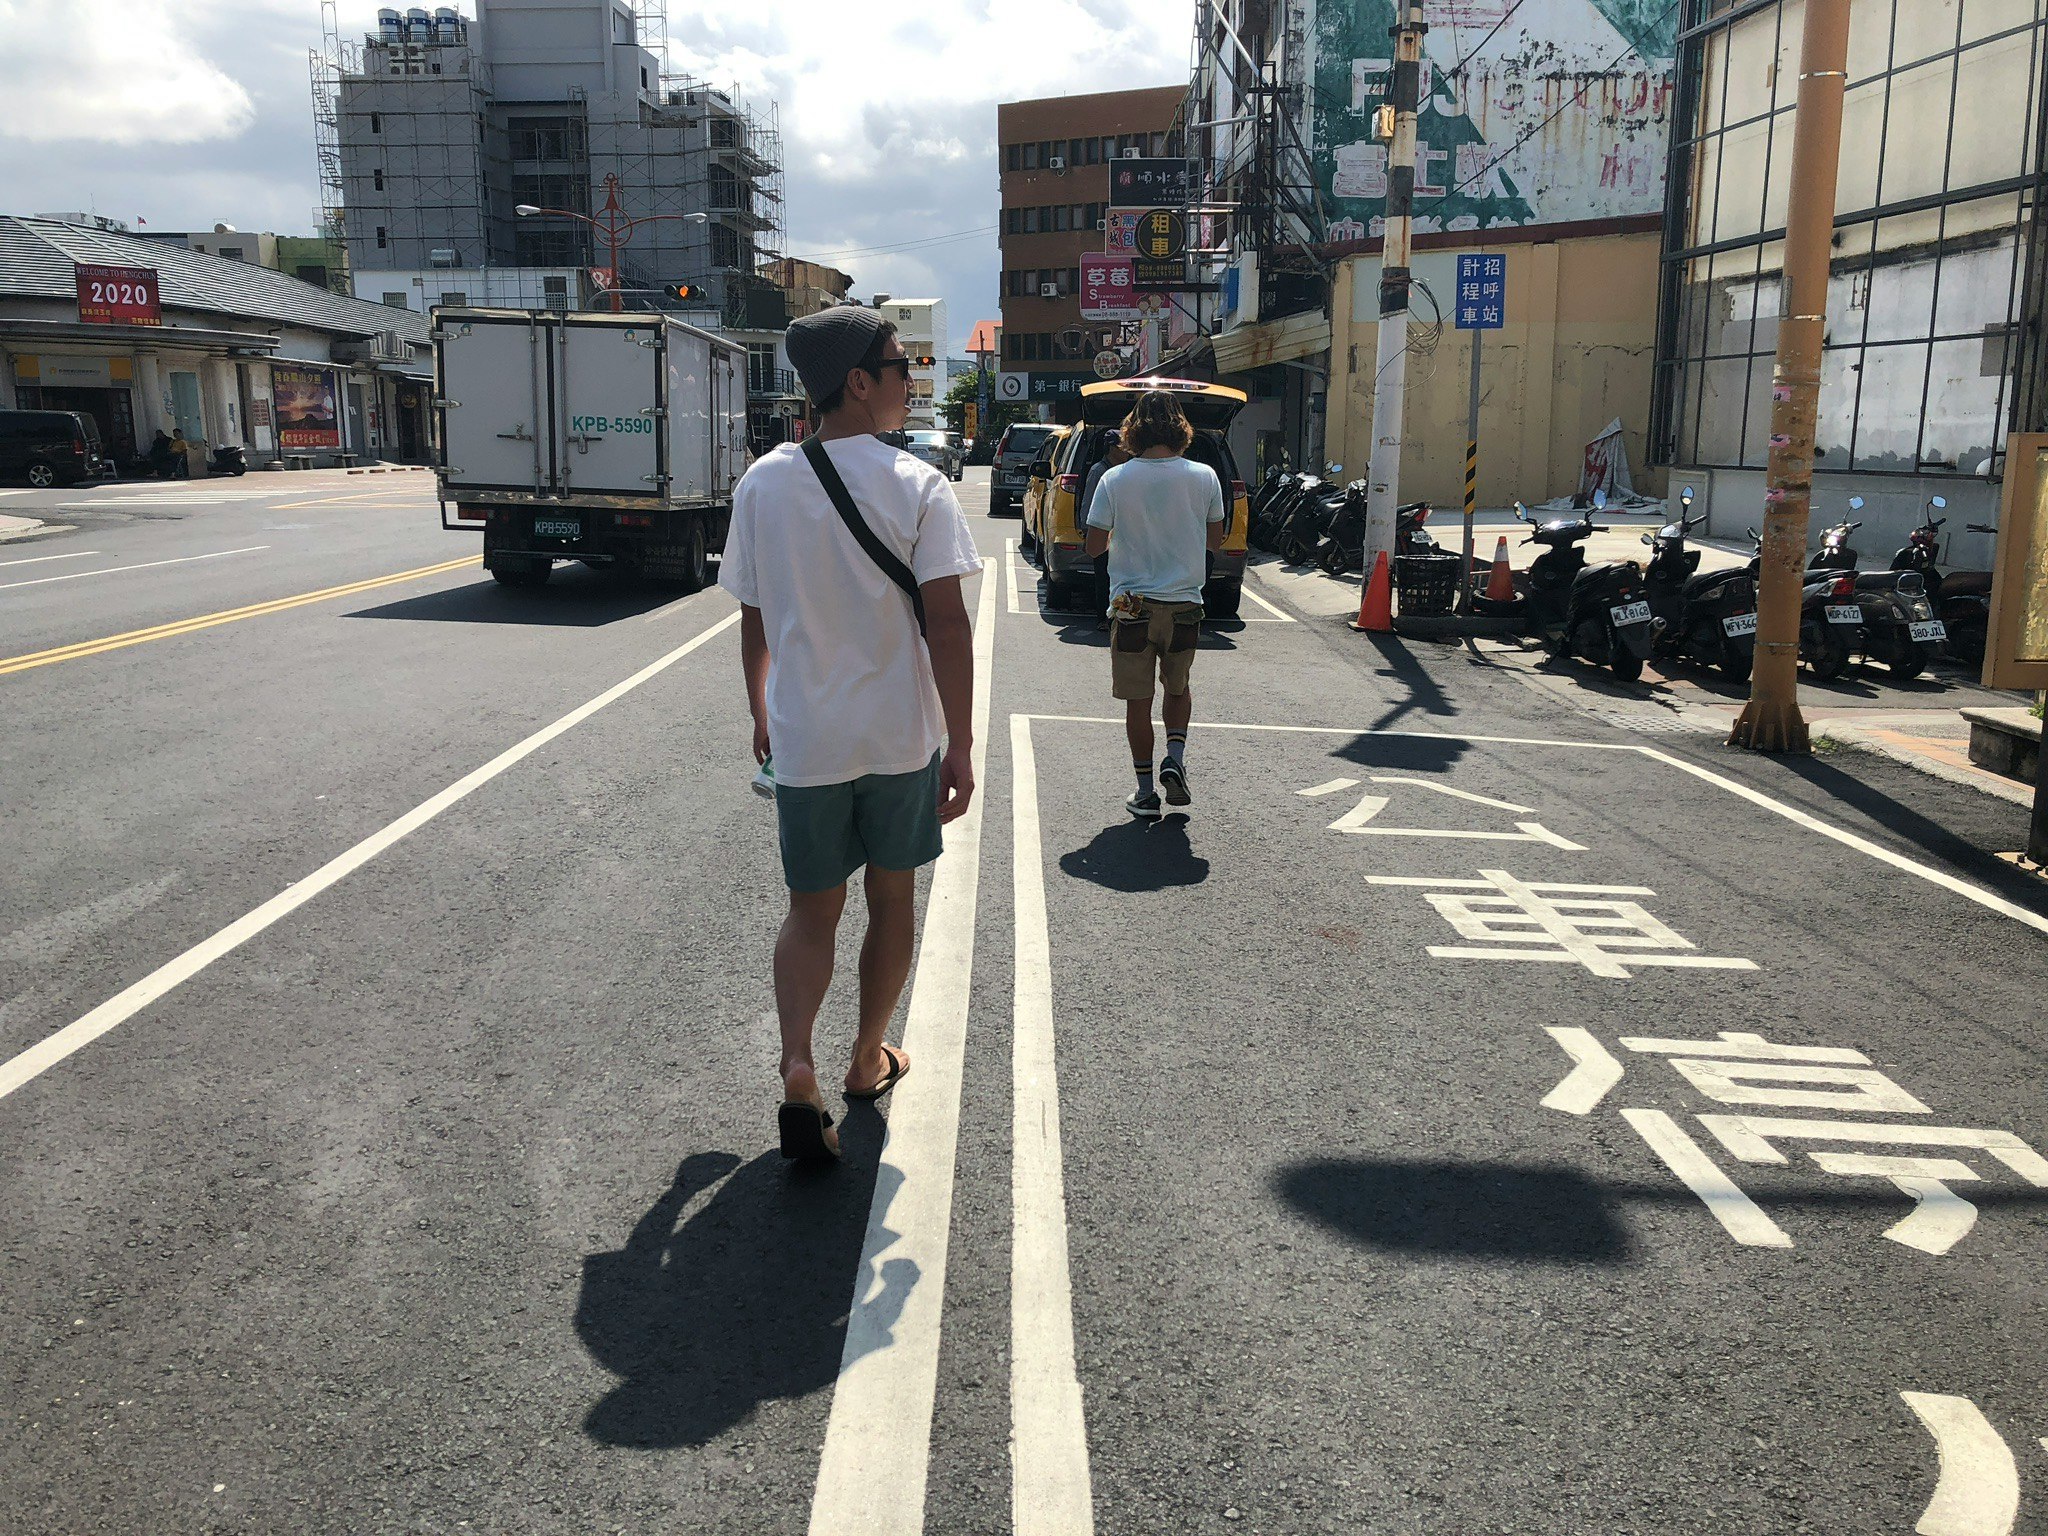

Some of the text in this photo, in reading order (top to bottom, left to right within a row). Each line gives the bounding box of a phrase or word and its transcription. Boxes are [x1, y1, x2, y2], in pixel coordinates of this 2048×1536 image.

[1151, 214, 1170, 256] 租車
[76, 266, 156, 280] WELCOME TO HENGCHUN
[1087, 267, 1130, 287] 草莓
[91, 282, 147, 305] 2020
[1462, 259, 1480, 325] 計程車
[1483, 258, 1500, 323] 招呼站
[1034, 379, 1082, 393] 第一銀行
[572, 416, 652, 434] KPB-5590
[1724, 616, 1757, 633] MFV-366
[1911, 626, 1945, 639] 380-JXL
